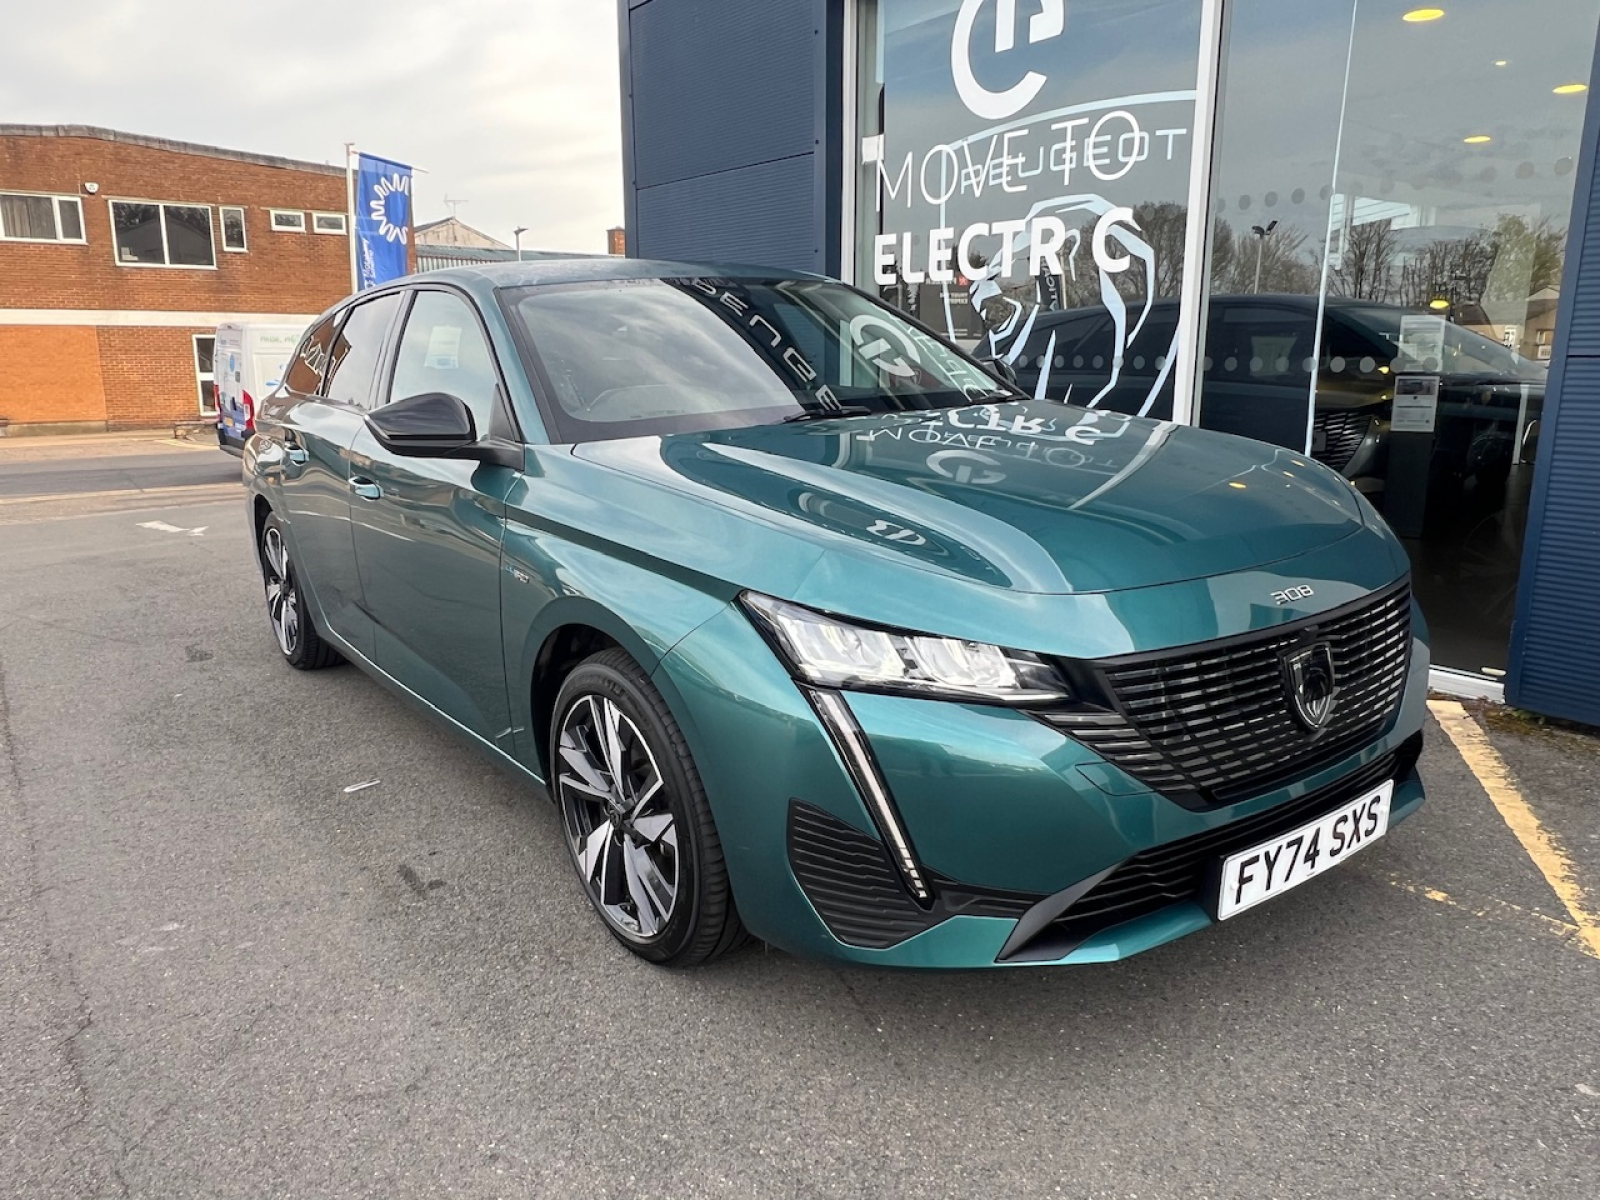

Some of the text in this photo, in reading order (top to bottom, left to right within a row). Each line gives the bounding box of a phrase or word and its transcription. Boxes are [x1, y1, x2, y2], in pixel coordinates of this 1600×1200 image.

[875, 111, 1141, 212] MOVE TO
[1270, 584, 1315, 605] 308
[1235, 795, 1382, 906] FY74 SXS
